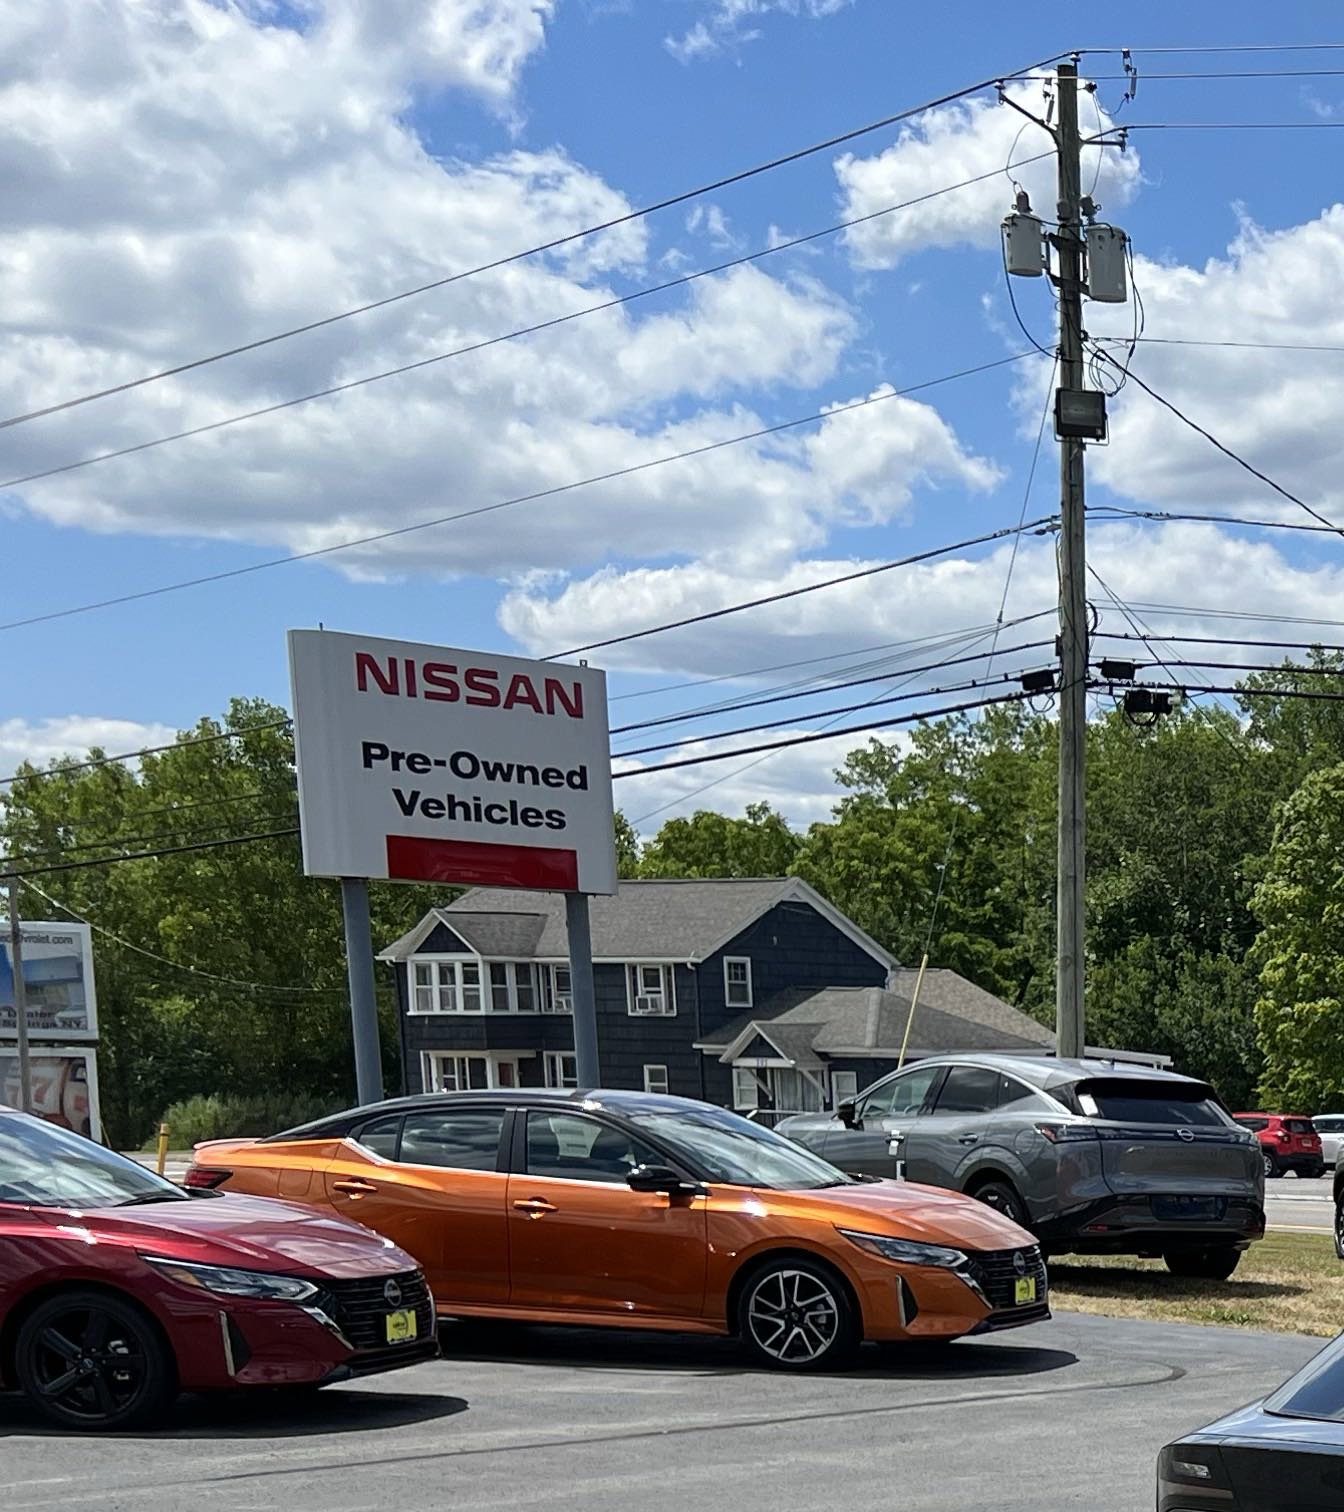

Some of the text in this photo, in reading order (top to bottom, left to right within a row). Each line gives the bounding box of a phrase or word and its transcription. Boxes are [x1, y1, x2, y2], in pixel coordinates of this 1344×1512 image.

[355, 652, 584, 719] NISSAN
[361, 741, 589, 791] Pre-Owned
[392, 788, 567, 830] Vehicles
